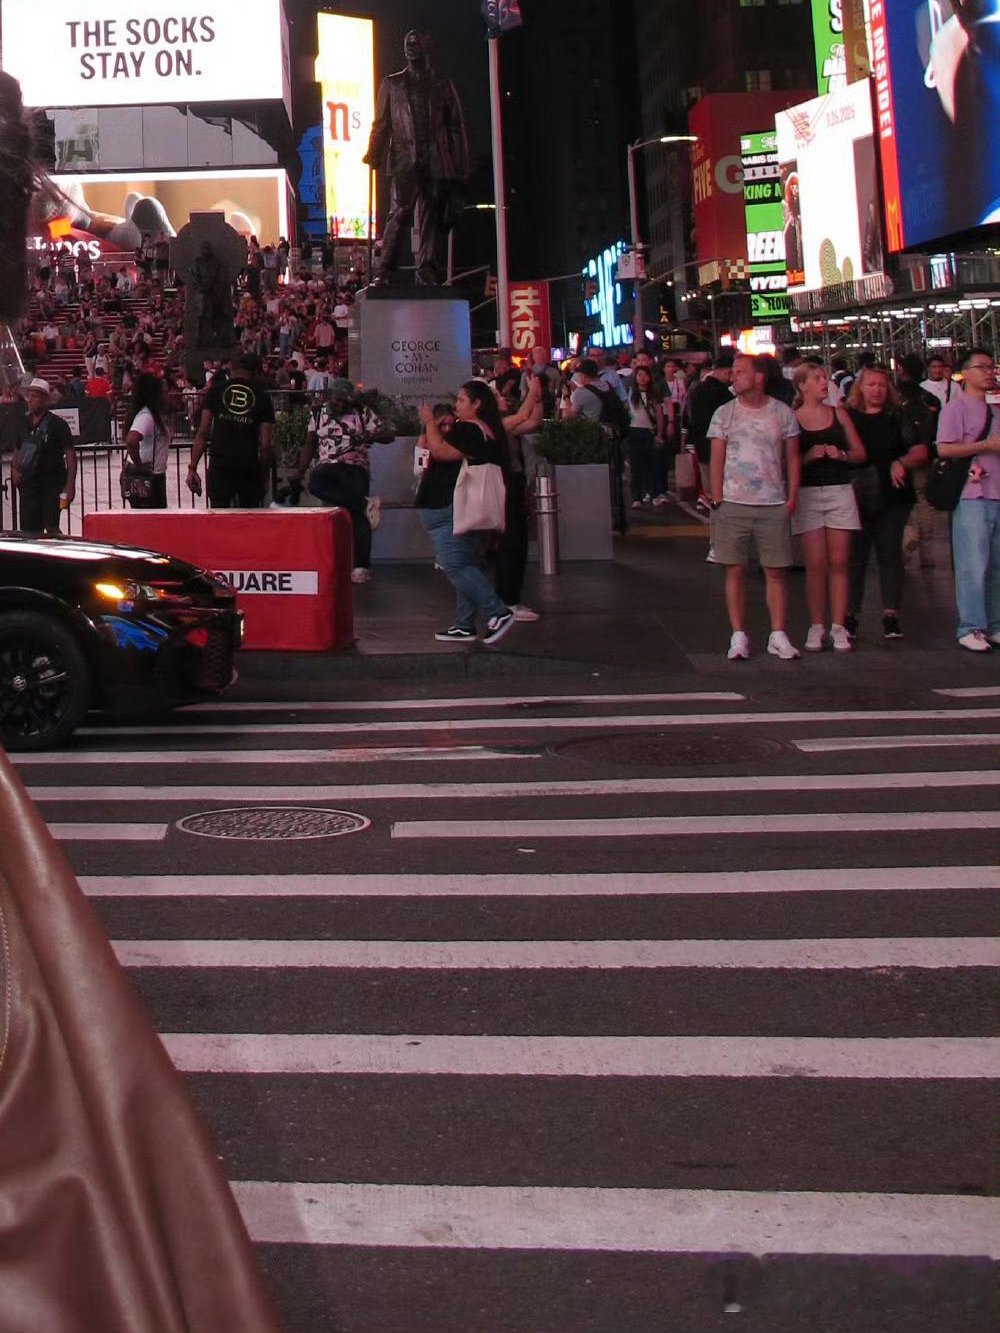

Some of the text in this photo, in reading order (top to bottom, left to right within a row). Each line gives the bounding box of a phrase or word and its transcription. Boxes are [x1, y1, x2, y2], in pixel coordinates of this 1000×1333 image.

[66, 16, 216, 48] THE SOCKS
[80, 49, 202, 80] STAY ON.
[391, 340, 441, 352] GEORGE
[395, 362, 438, 374] COHAN
[213, 572, 293, 591] QUARE
